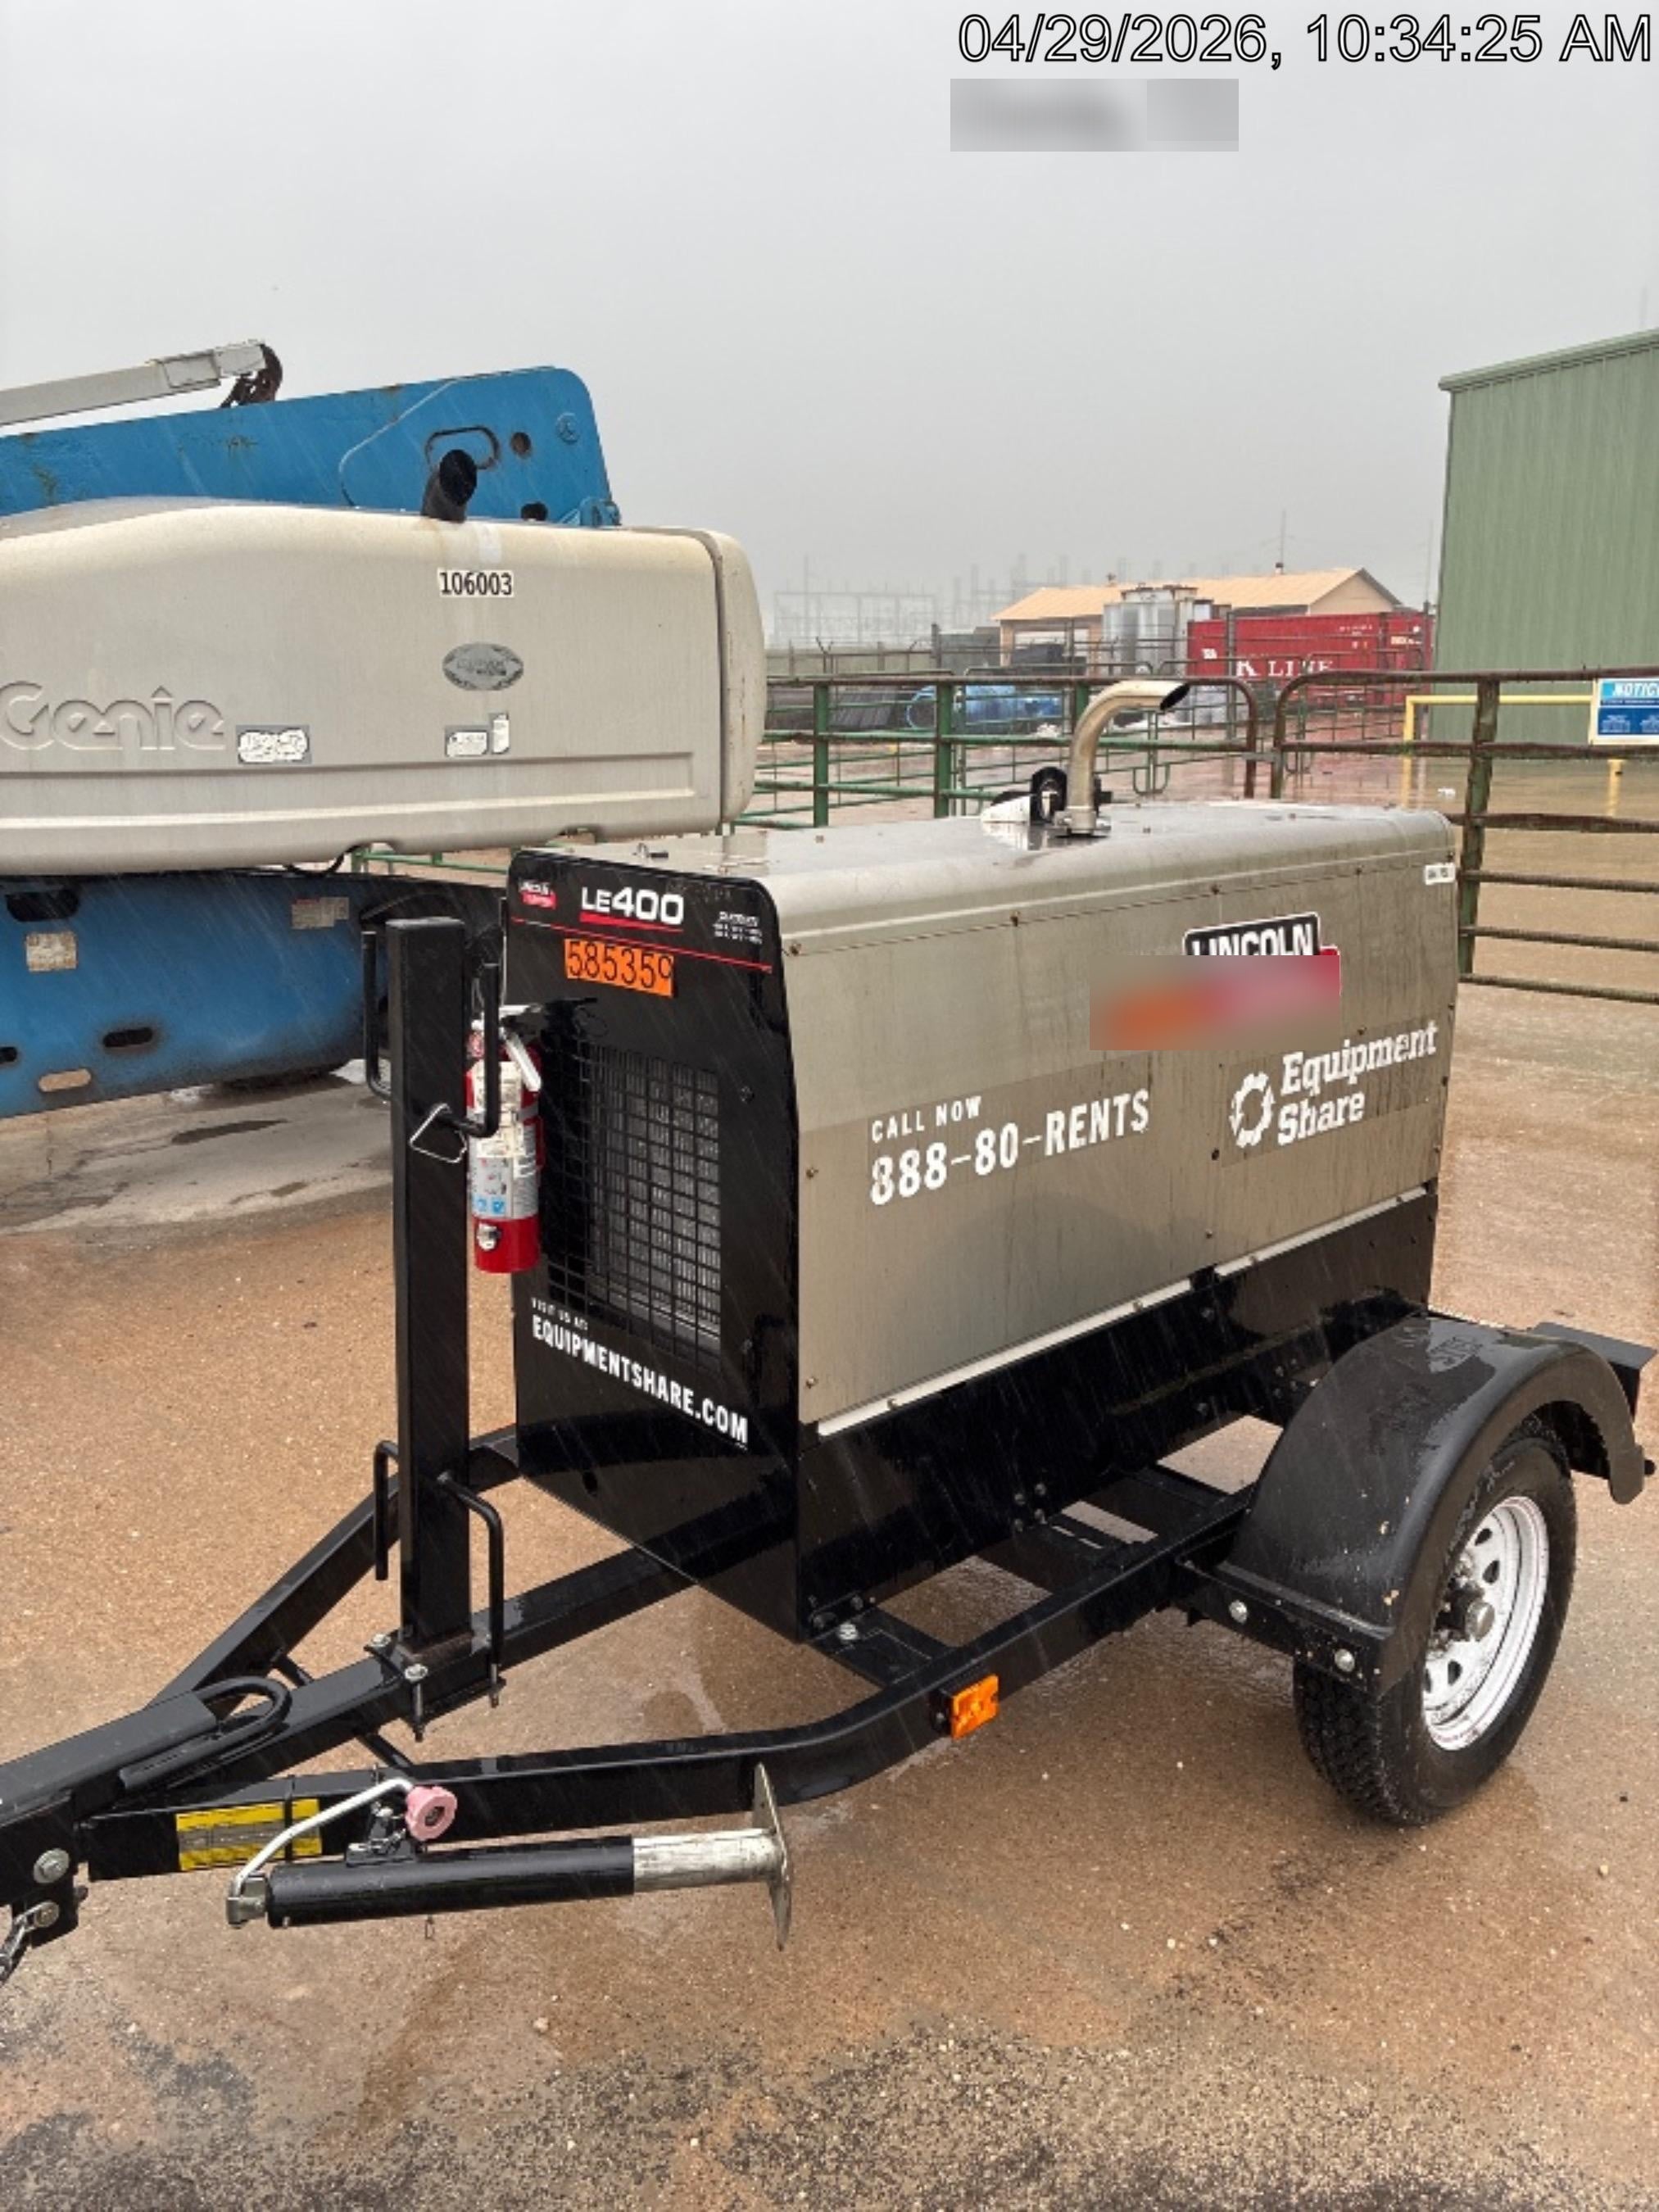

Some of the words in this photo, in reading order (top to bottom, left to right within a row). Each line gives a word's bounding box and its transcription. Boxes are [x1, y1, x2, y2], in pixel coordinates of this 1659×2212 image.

[439, 572, 512, 596] 106003
[1236, 660, 1261, 678] K
[0, 681, 226, 750] Genie
[580, 886, 685, 925] LE400
[1281, 1020, 1439, 1097] Equipment
[871, 1110, 925, 1144] CALL
[936, 1095, 982, 1126] NOW
[1277, 1090, 1366, 1146] Share
[870, 1088, 1150, 1206] 888-80-RENTS
[533, 1313, 748, 1444] EQUIPMENTSHARE.COM
